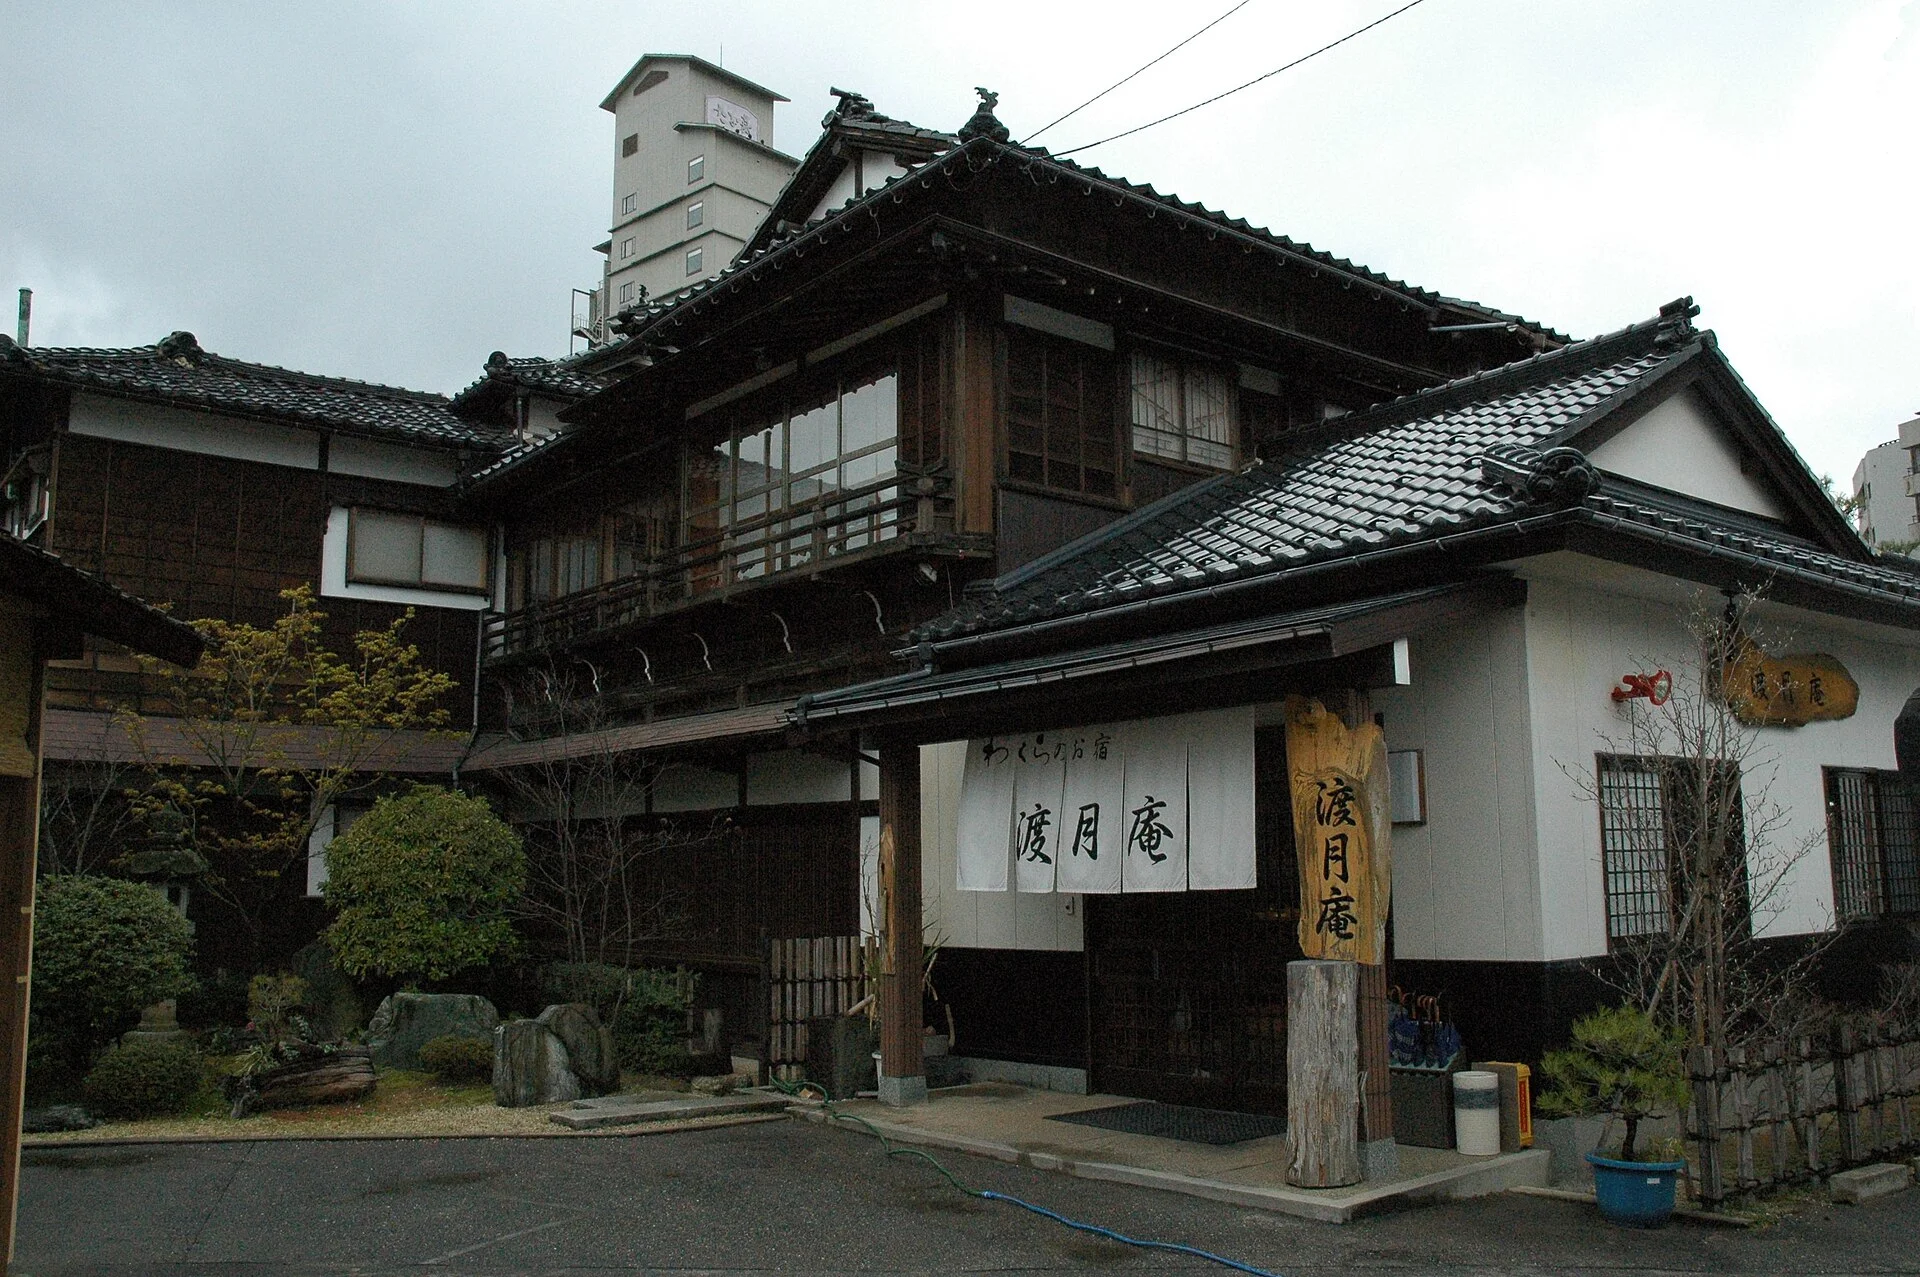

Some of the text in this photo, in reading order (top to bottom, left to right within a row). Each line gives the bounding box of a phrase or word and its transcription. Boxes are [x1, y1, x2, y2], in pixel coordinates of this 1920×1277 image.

[1016, 796, 1174, 865] 渡月庵
[1315, 777, 1357, 940] 渡月庵
